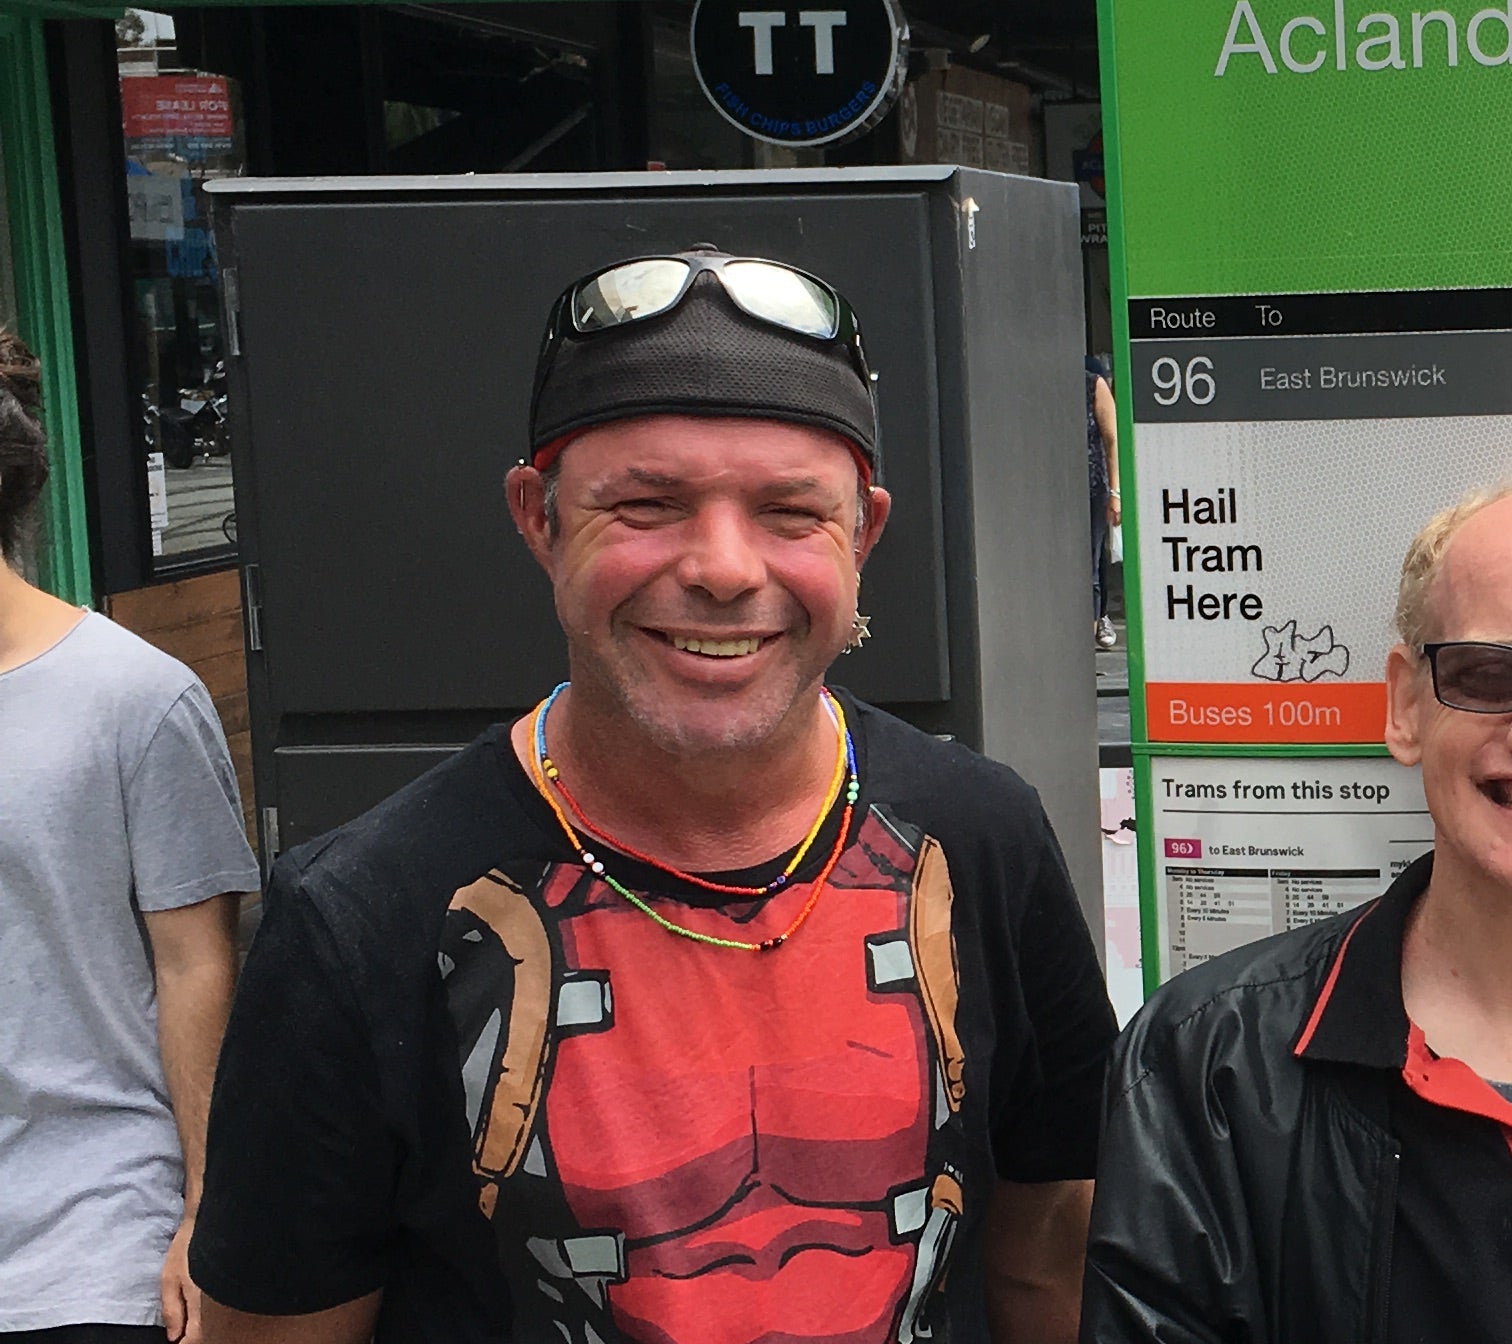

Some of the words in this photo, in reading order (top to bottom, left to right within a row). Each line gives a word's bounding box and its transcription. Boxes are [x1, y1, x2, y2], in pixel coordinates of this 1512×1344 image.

[715, 82, 747, 119] FISH
[750, 112, 801, 137] CHIPS
[806, 80, 877, 136] BURGERS
[1149, 306, 1217, 331] Route
[1256, 305, 1283, 326] To
[1151, 357, 1217, 407] 96
[1260, 366, 1311, 391] East
[1319, 363, 1446, 390] Brunswick
[1161, 487, 1238, 526] Hail
[1161, 536, 1264, 573] Tram
[1166, 583, 1264, 622] Here
[1170, 699, 1253, 727] Buses
[1262, 700, 1341, 727] 100m
[1162, 779, 1227, 798] Trams
[1233, 781, 1285, 800] from
[1291, 781, 1333, 800] this
[1340, 782, 1390, 804] stop
[1172, 843, 1187, 854] 96
[1209, 846, 1220, 856] to
[1223, 846, 1246, 856] East
[1248, 846, 1304, 857] Brunswick
